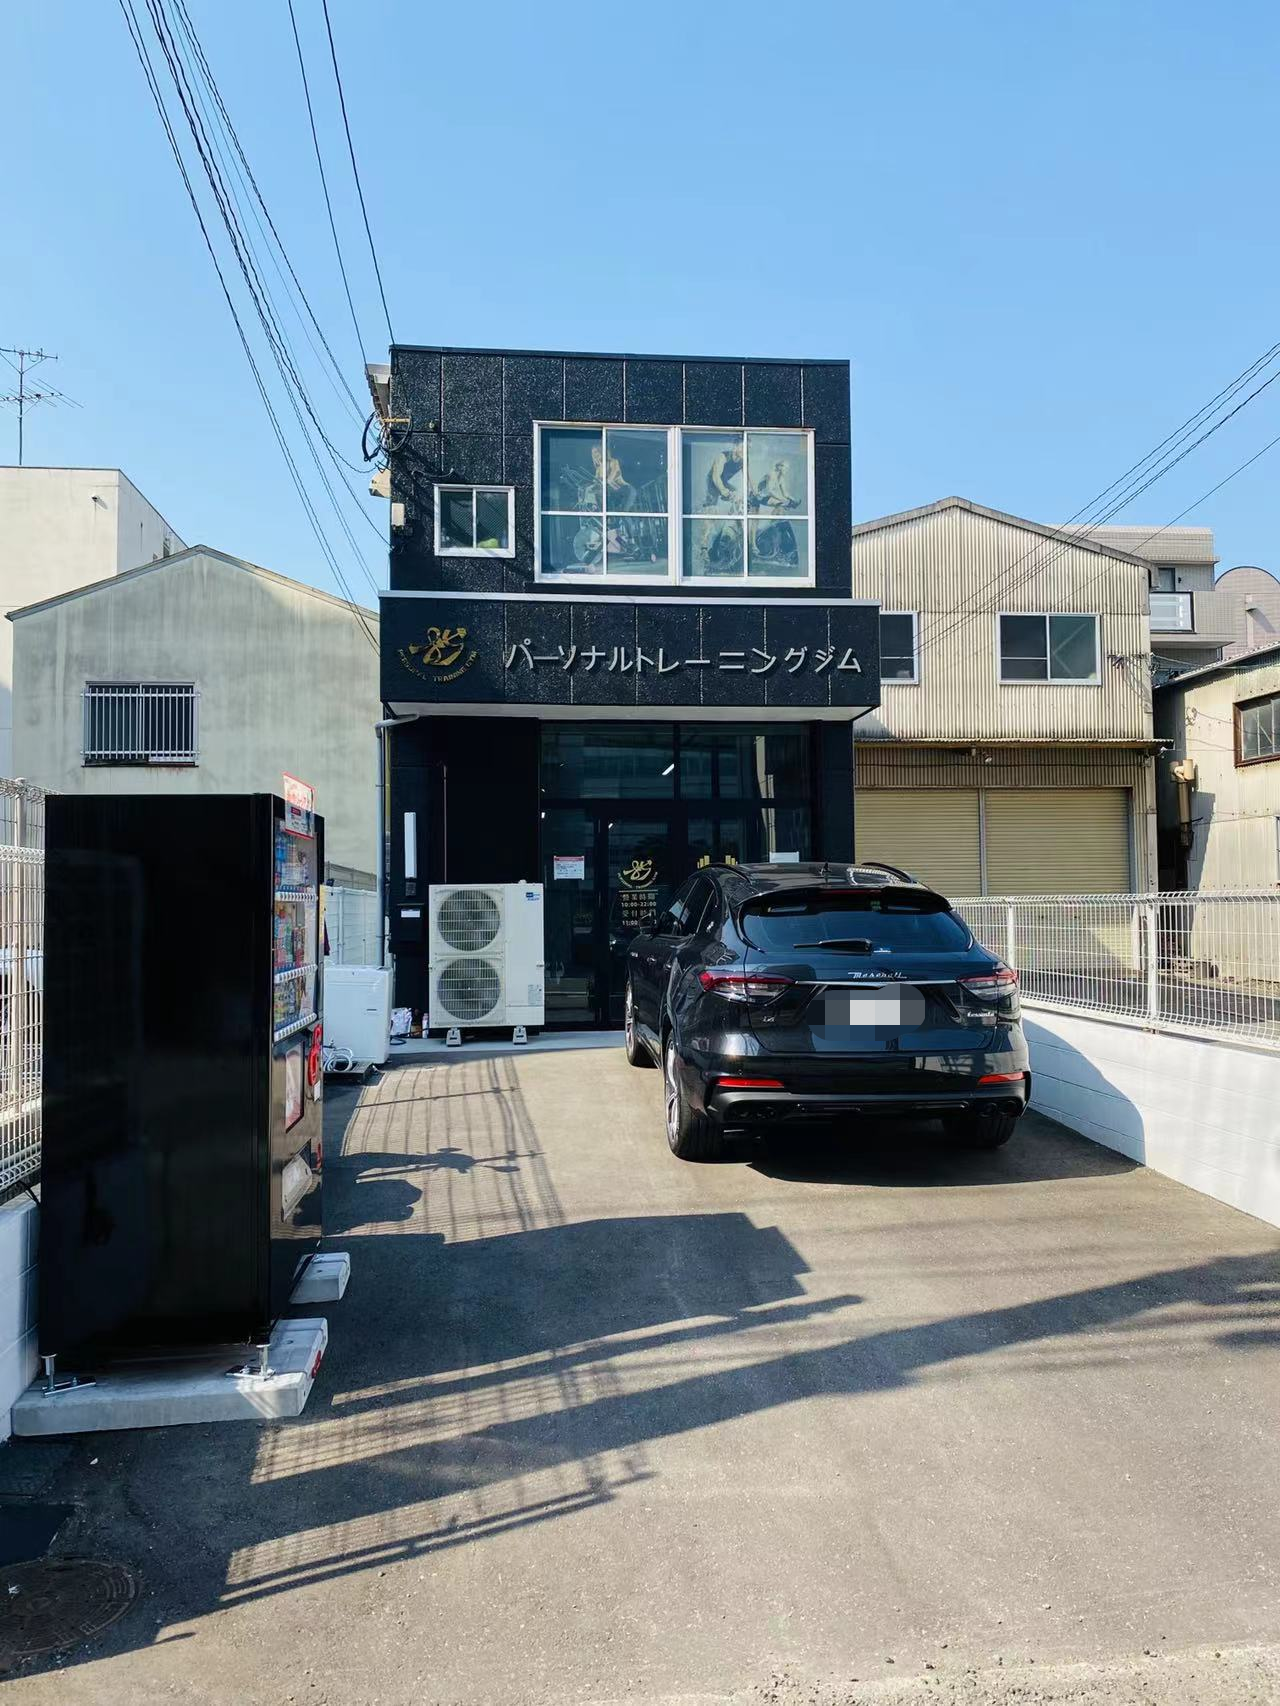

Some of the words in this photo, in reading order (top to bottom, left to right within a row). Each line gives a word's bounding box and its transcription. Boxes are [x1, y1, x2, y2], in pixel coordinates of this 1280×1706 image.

[504, 639, 862, 676] パーソナルトレーニングジム
